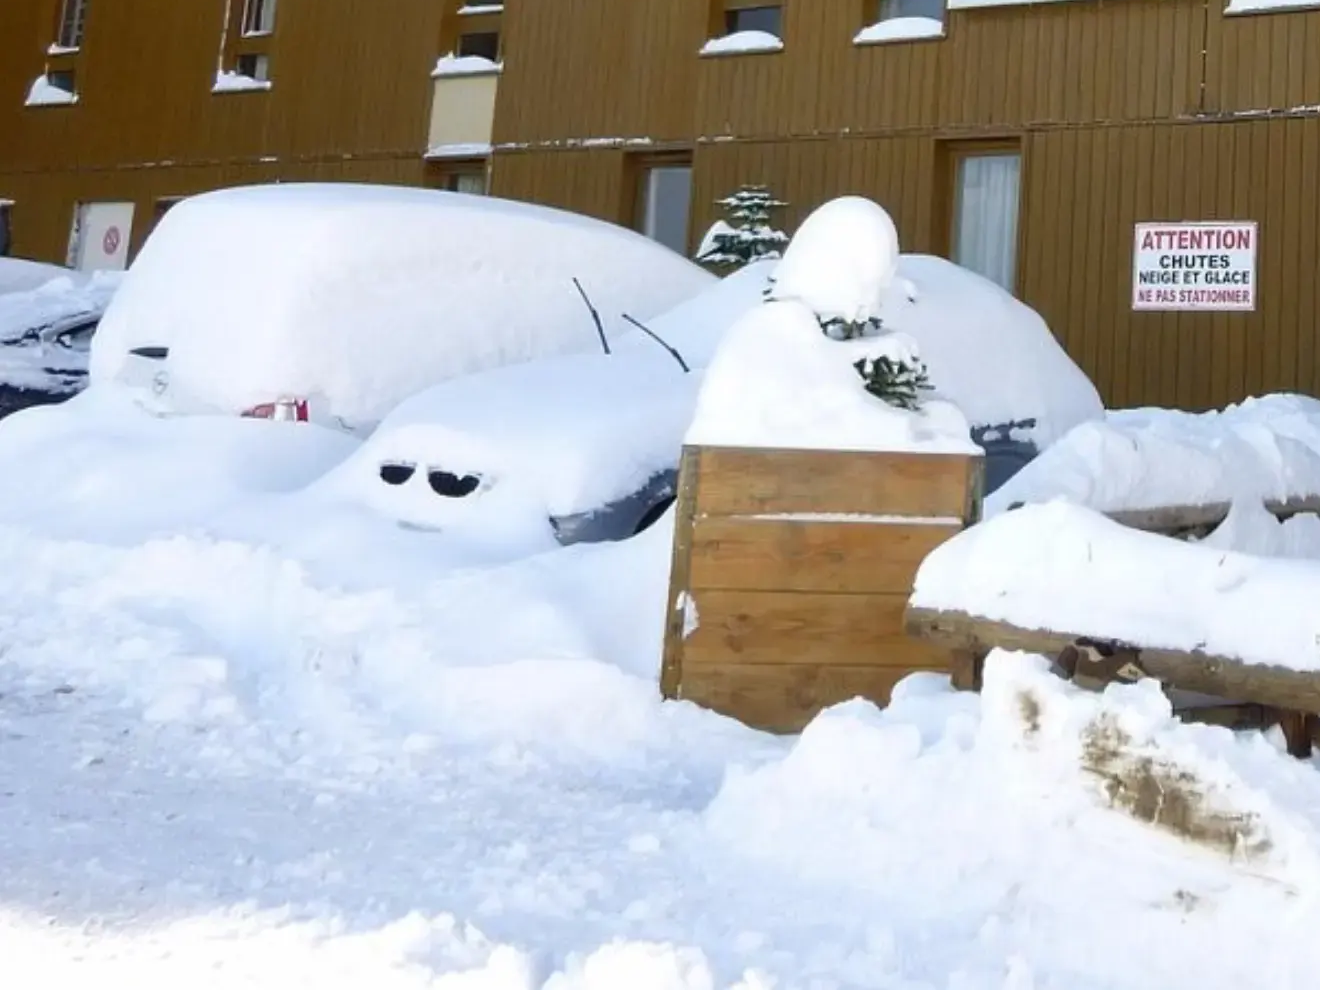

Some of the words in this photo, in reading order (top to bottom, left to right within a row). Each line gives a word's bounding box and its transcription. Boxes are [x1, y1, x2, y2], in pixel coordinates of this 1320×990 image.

[1141, 230, 1250, 250] ATTENTION
[1159, 254, 1230, 269] CHUTES
[1139, 270, 1179, 285] NEIGE
[1183, 271, 1200, 285] ET
[1204, 270, 1250, 285] GLACE
[1138, 290, 1152, 303] NE
[1155, 290, 1176, 303] PAS
[1179, 289, 1250, 304] STATIONNER
